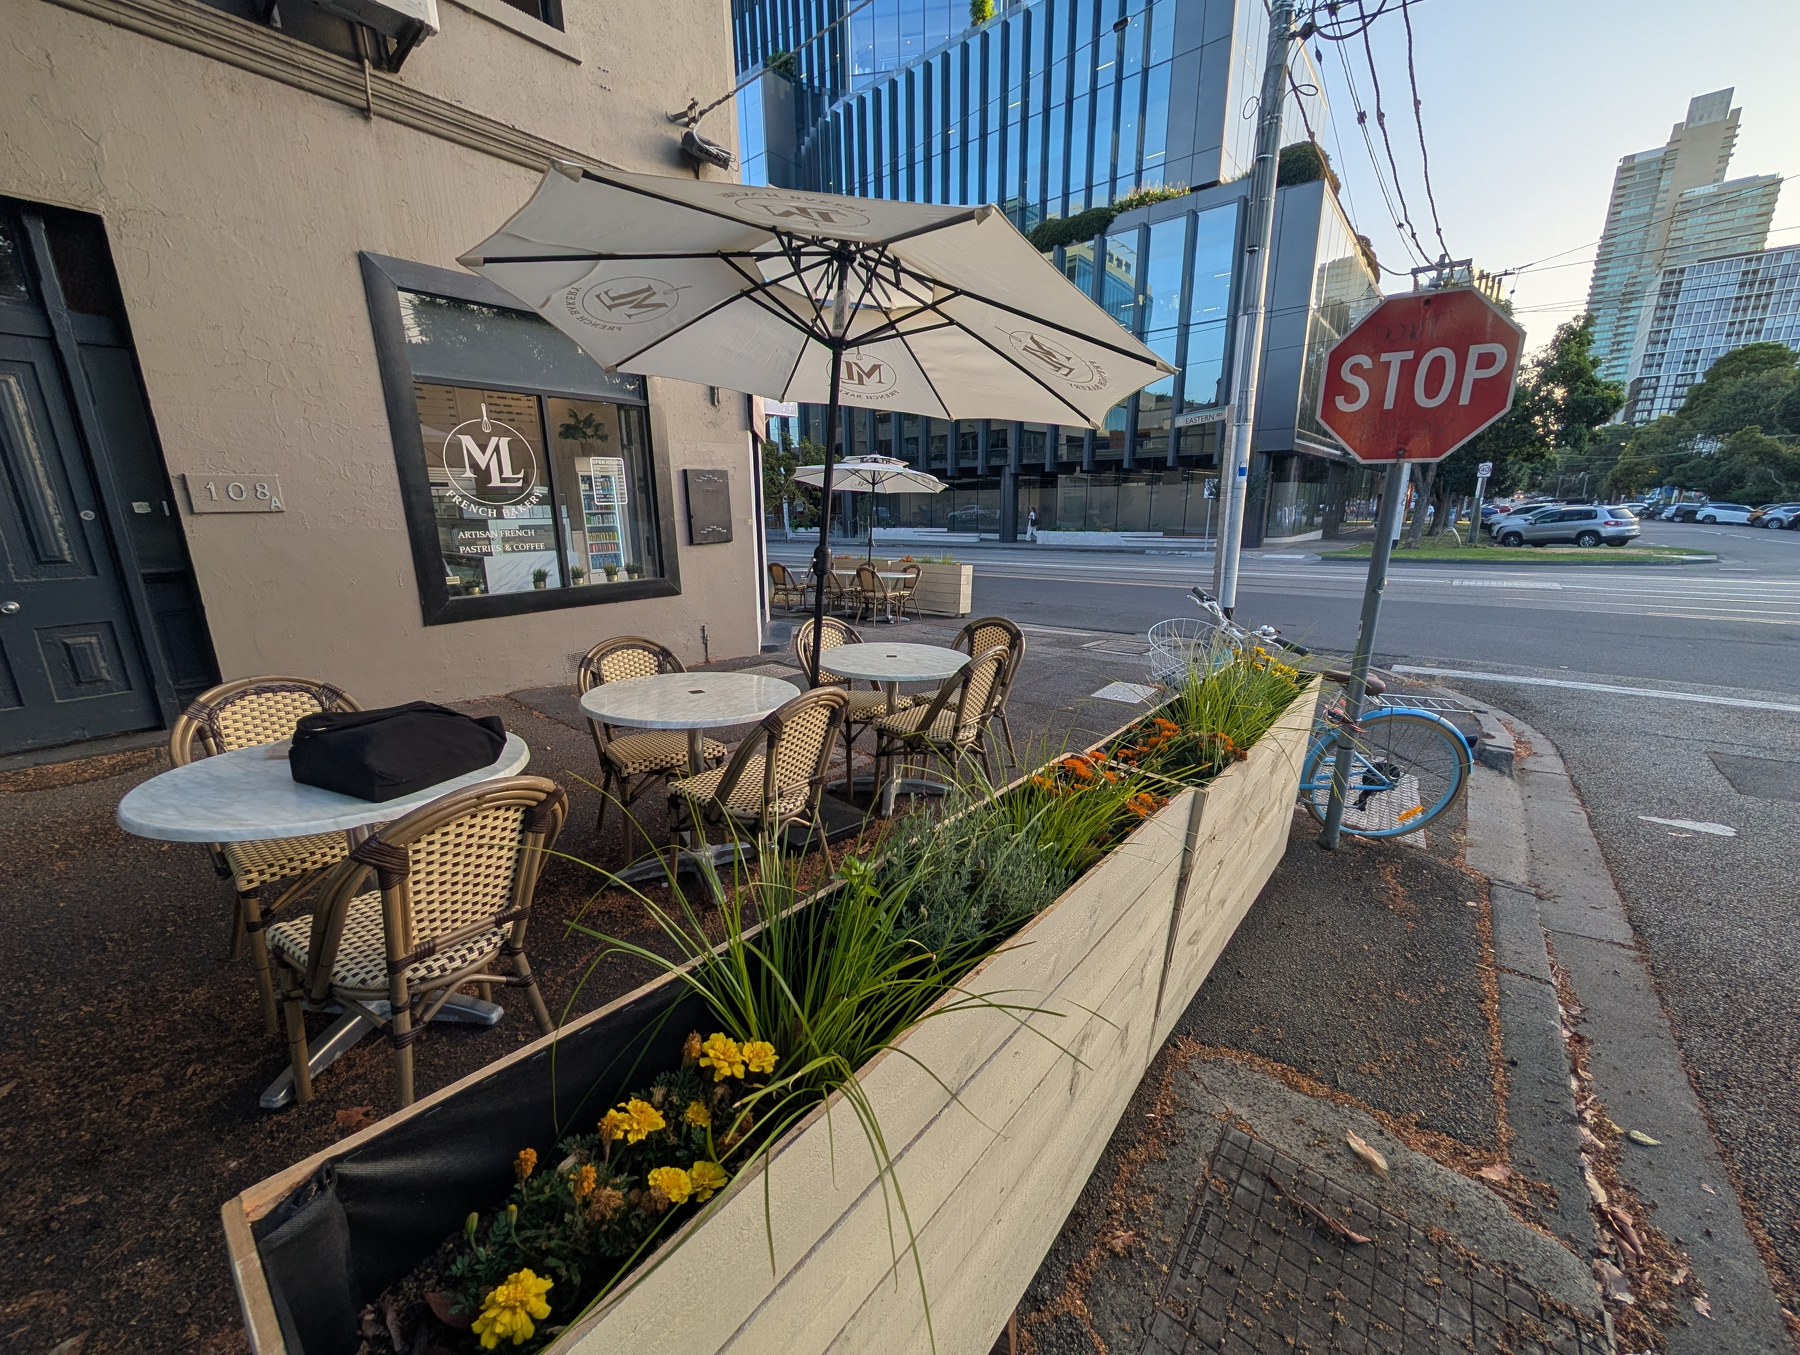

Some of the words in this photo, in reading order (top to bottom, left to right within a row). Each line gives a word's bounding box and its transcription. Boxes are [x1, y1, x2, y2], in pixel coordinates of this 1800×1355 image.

[1335, 343, 1508, 413] STOP
[1185, 413, 1215, 425] EASTERN
[445, 490, 497, 518] FRENCH
[503, 490, 543, 517] BAKERY
[458, 530, 498, 539] ARTISAN
[500, 529, 535, 538] FRENCH
[459, 544, 502, 554] PASTRIES
[505, 544, 512, 552] &
[513, 542, 546, 551] COFFEE
